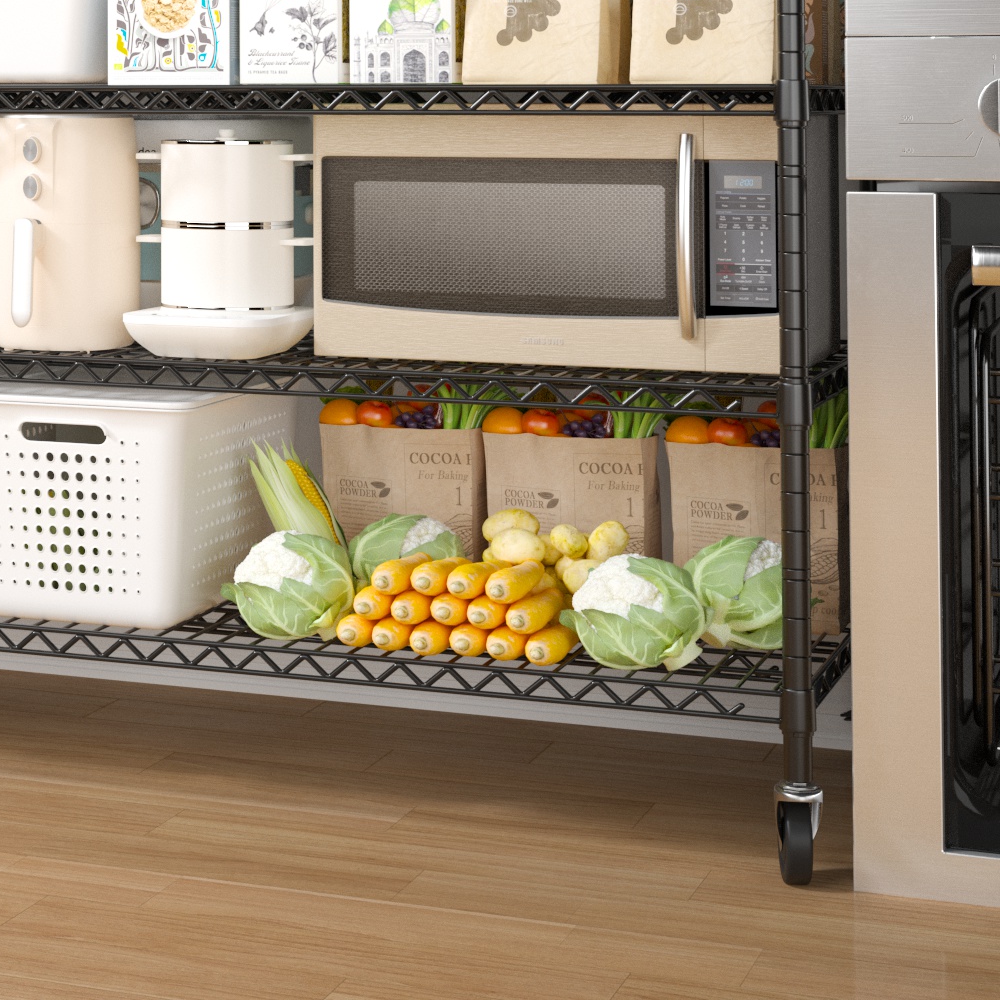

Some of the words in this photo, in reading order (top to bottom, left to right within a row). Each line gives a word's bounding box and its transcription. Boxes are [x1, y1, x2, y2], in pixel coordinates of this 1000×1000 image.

[409, 452, 462, 465] COCOA
[578, 461, 633, 475] COCOA
[417, 469, 435, 480] For
[437, 470, 468, 482] Baking
[339, 478, 369, 490] COCOA
[587, 480, 605, 491] For
[608, 480, 640, 493] Baking
[339, 487, 377, 498] POWDER
[504, 488, 535, 500] COCOA
[504, 496, 544, 509] POWDER
[690, 500, 724, 511] COCOA
[690, 509, 733, 521] POWDER
